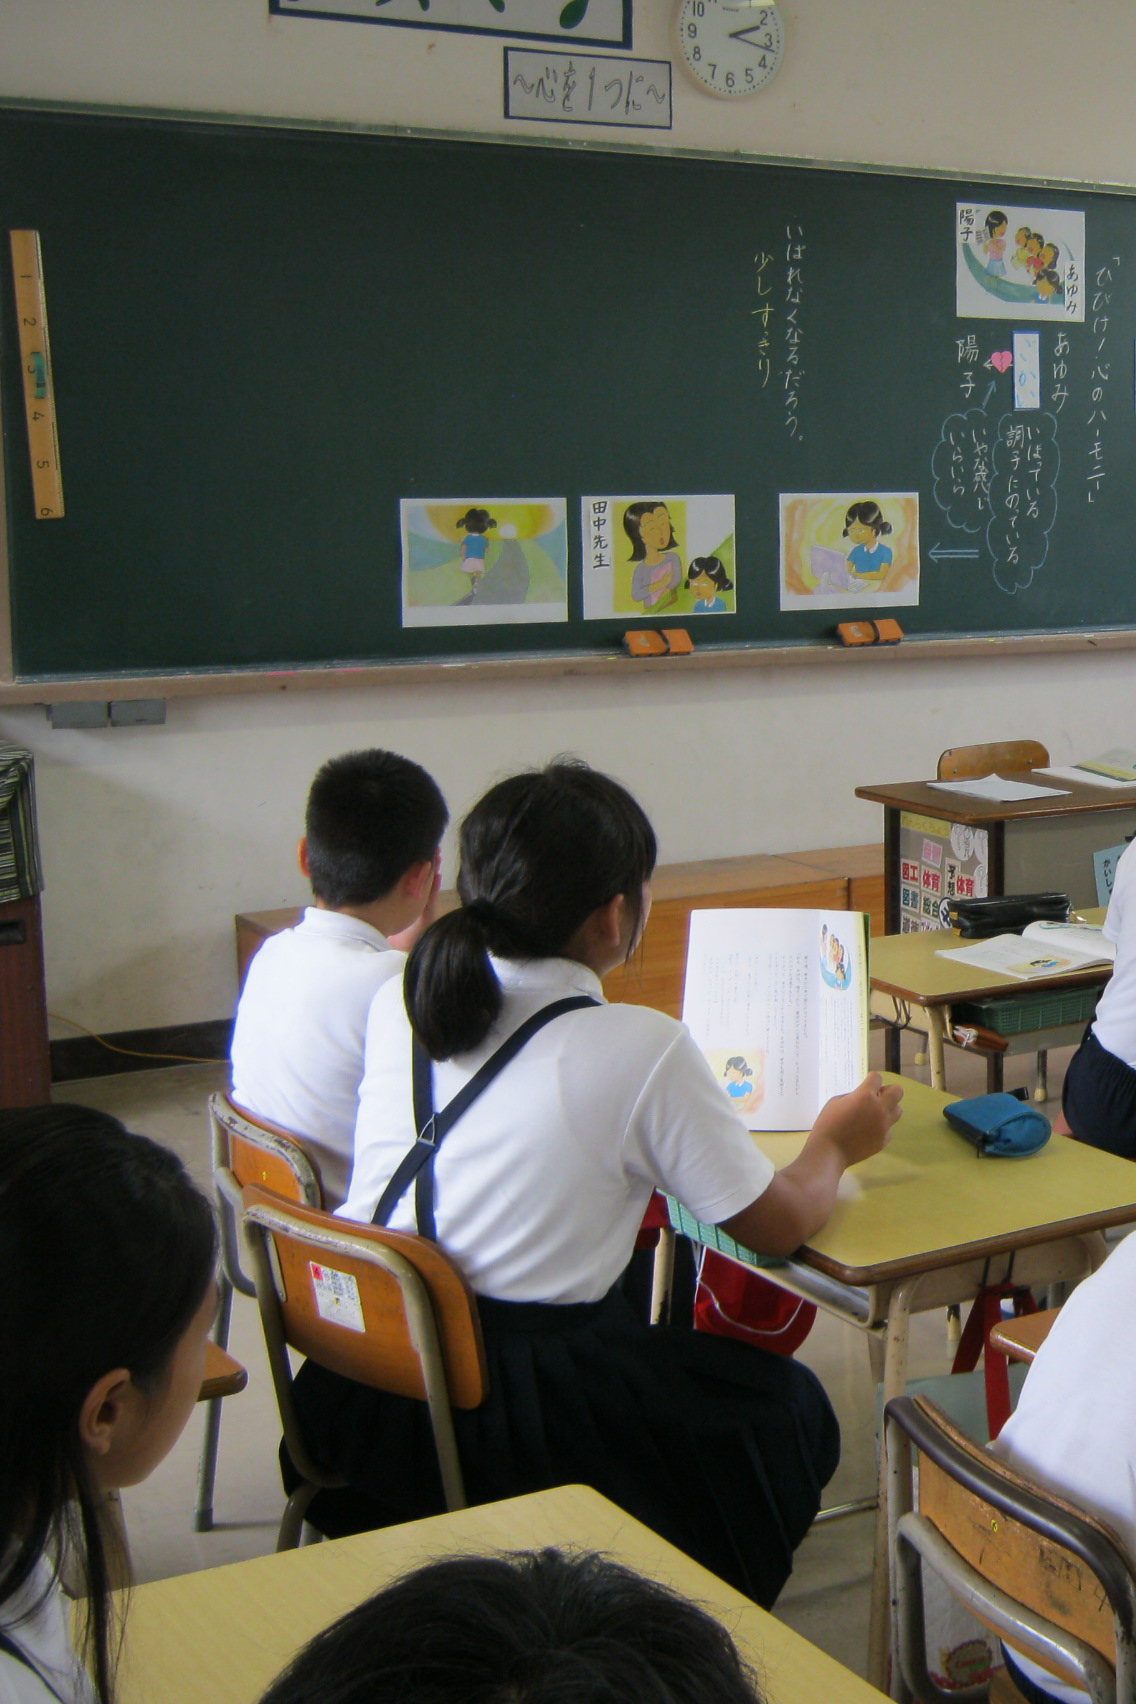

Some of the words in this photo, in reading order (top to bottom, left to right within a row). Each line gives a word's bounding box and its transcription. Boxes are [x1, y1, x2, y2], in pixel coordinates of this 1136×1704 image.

[692, 1, 704, 17] 10
[760, 10, 768, 26] 2
[687, 23, 697, 38] 9
[764, 33, 773, 48] 3
[692, 46, 702, 61] 8
[758, 54, 767, 70] 4
[708, 63, 717, 80] 7
[745, 68, 754, 84] 5
[725, 72, 735, 88] 6
[959, 208, 975, 242] 陽子
[1066, 263, 1079, 315] あゆみ
[23, 317, 37, 327] 2
[751, 251, 775, 389] 少しすっきり
[956, 334, 979, 399] 陽子
[1051, 331, 1070, 414] あゆみ
[32, 411, 45, 422] 4
[36, 460, 50, 469] 5
[949, 431, 966, 496] いらいら
[1005, 424, 1024, 565] 調子にのっている
[40, 507, 54, 517] 6
[592, 501, 611, 569] 田中先生
[922, 870, 941, 892] 体育
[956, 875, 974, 897] 体育
